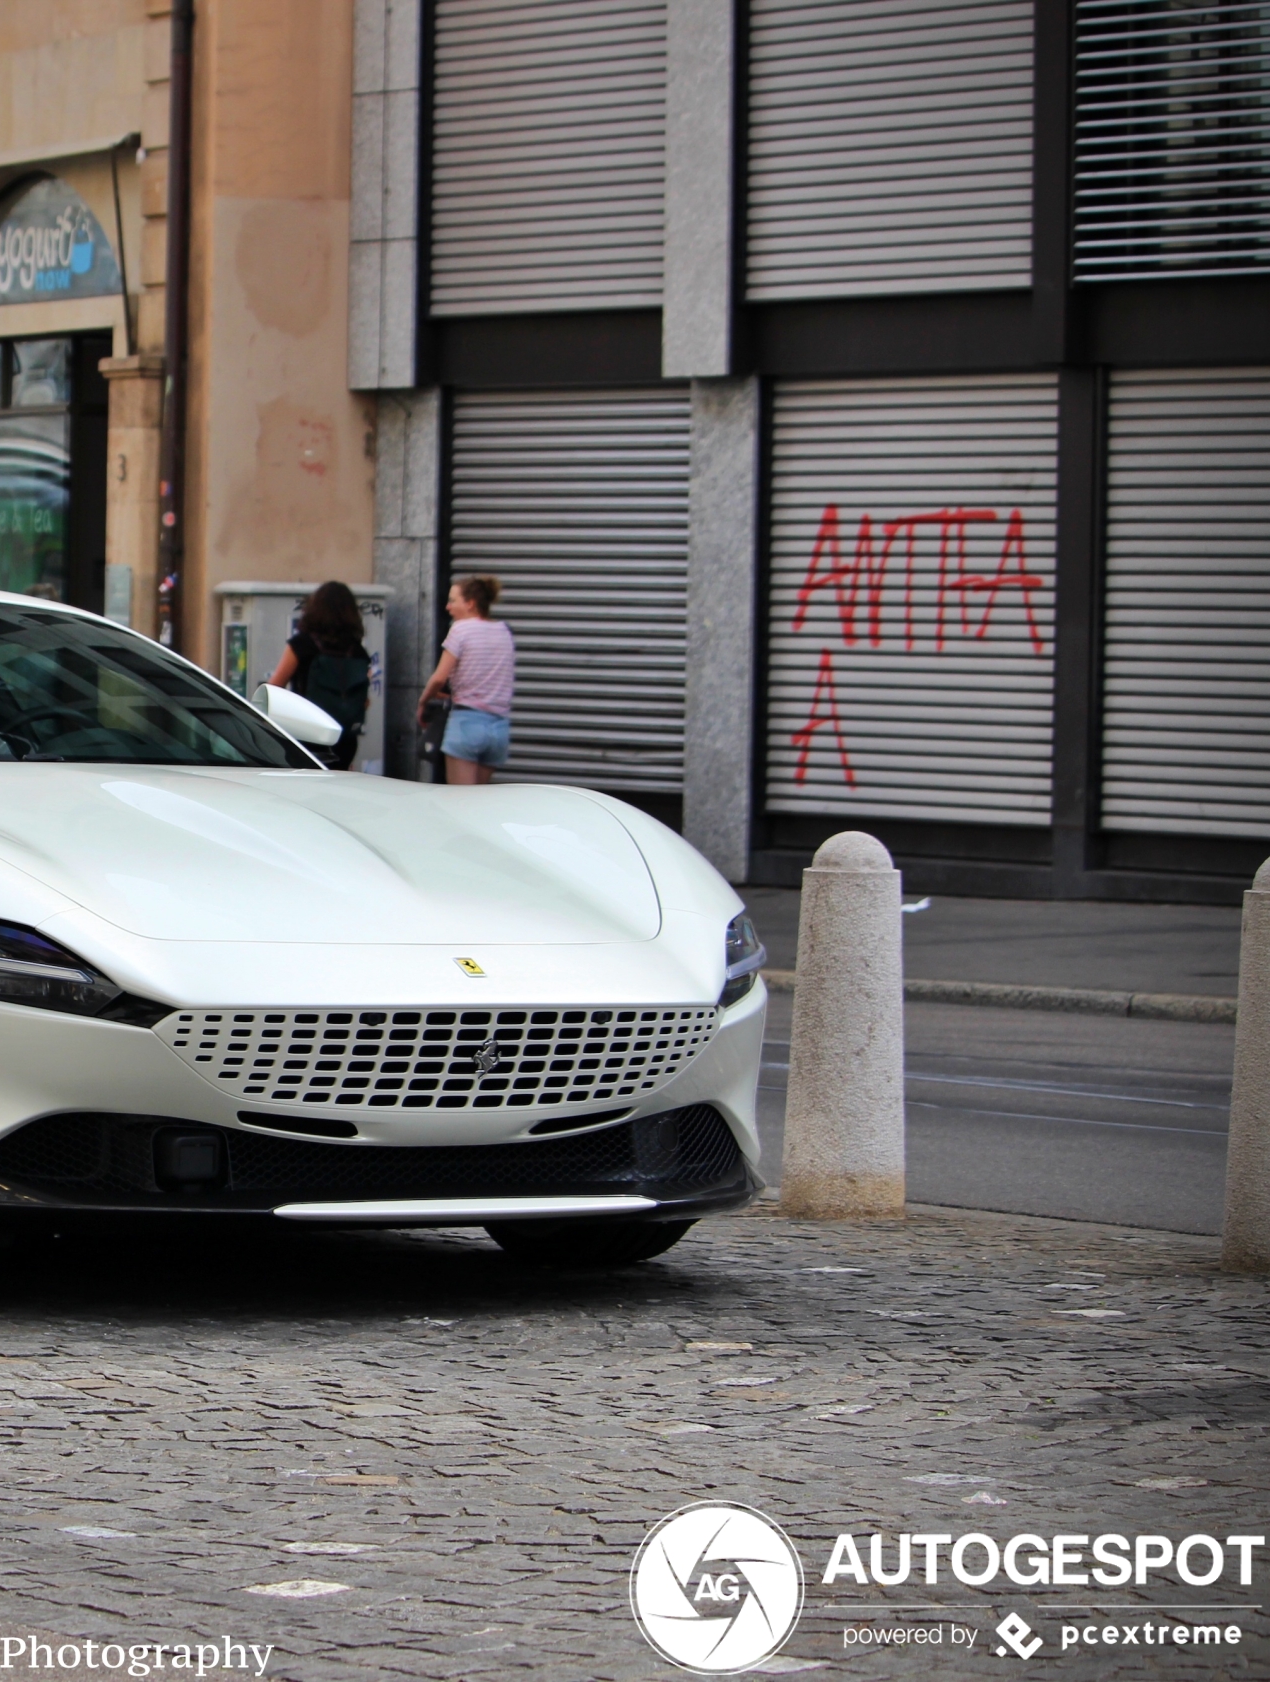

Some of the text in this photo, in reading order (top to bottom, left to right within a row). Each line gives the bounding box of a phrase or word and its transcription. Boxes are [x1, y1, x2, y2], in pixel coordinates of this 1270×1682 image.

[34, 269, 71, 293] now
[117, 453, 127, 482] 3
[791, 503, 1044, 655] ANTIFA
[790, 648, 858, 791] A
